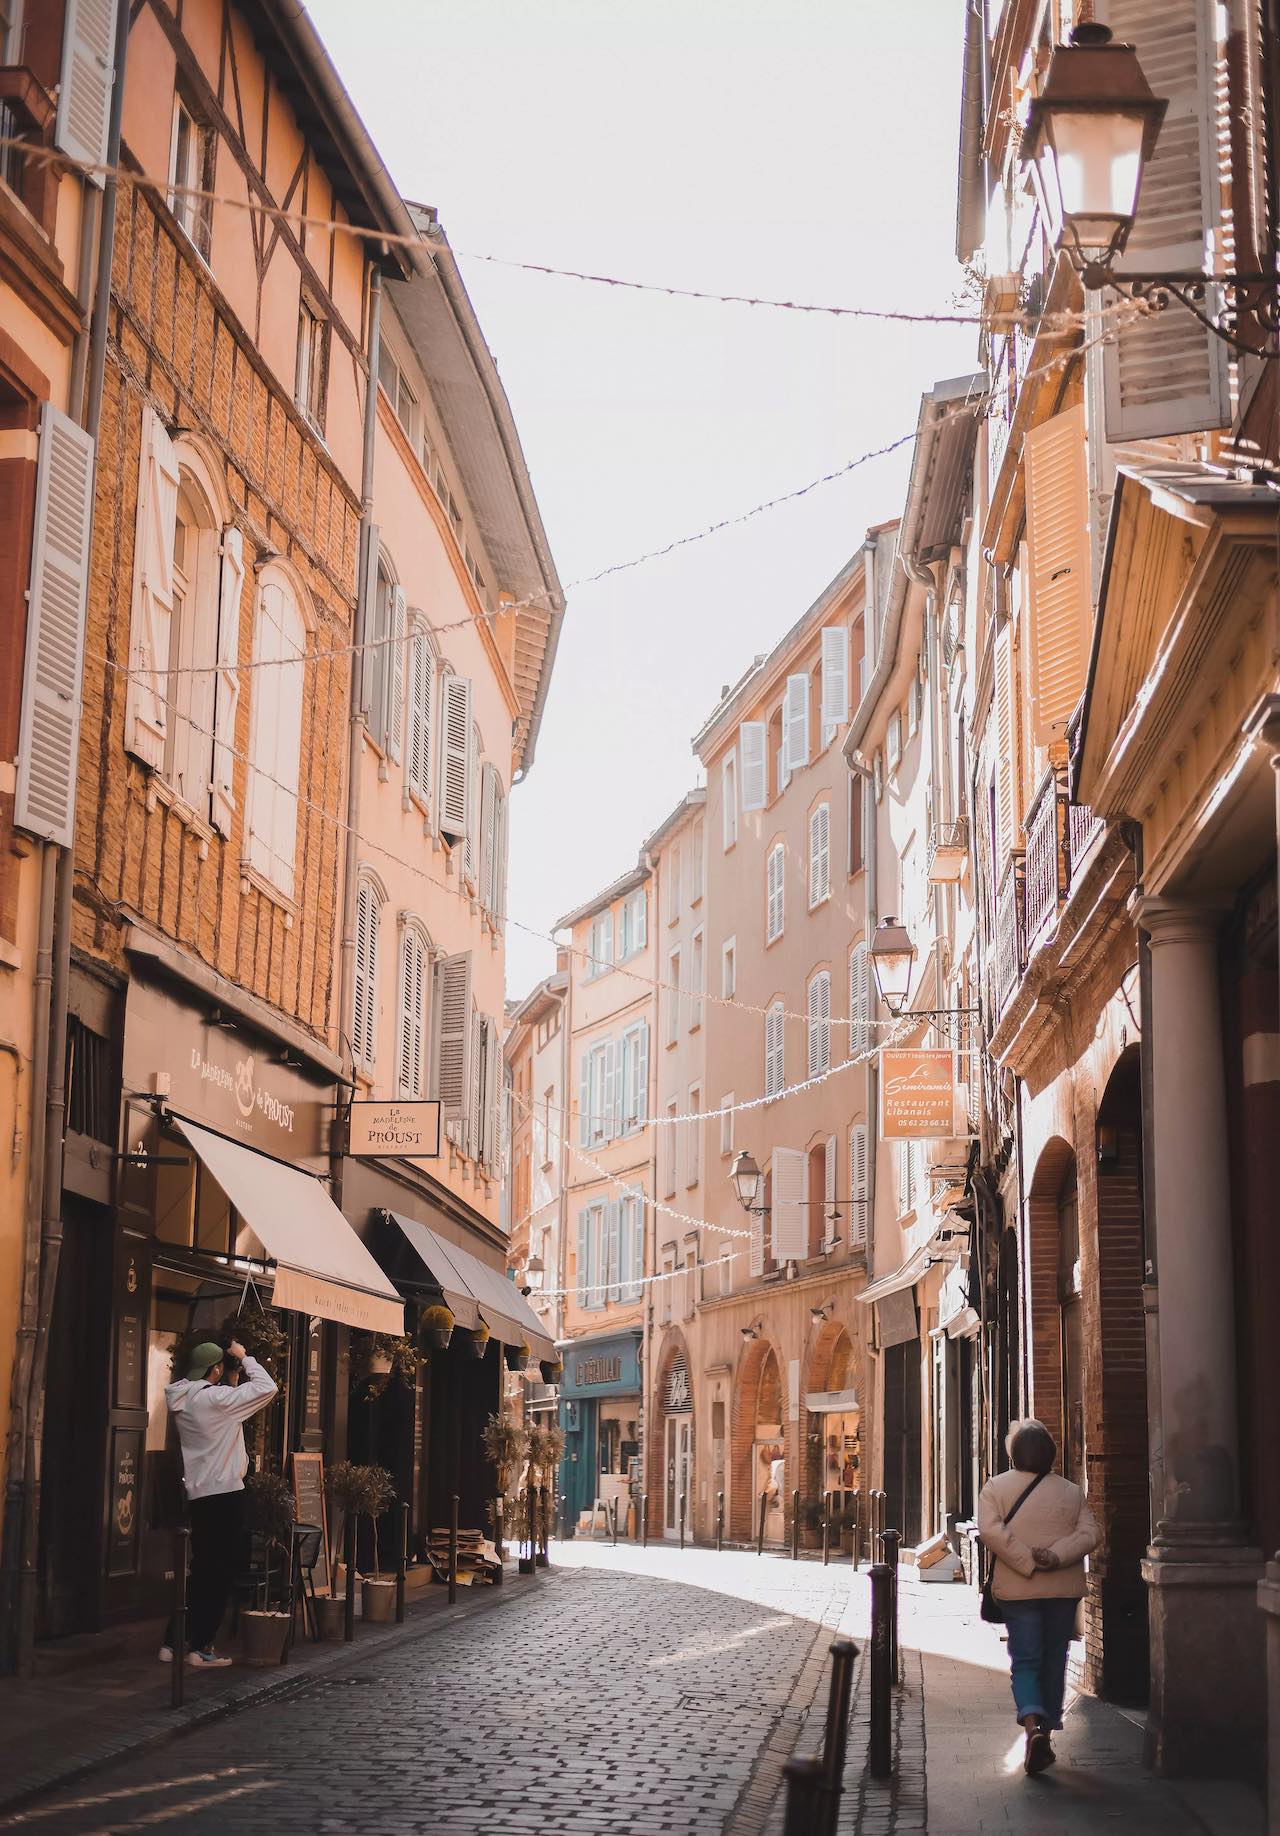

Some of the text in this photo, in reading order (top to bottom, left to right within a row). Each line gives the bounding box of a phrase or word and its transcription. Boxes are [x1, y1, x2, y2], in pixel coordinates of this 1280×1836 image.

[909, 1063, 928, 1079] Le
[201, 1061, 234, 1091] MADELEINE
[264, 1091, 294, 1132] PROUST
[887, 1099, 949, 1107] Restaurant
[886, 1107, 932, 1116] Libanais
[373, 1116, 416, 1124] MADELEINE
[389, 1123, 397, 1131] de
[368, 1130, 422, 1144] PROUST
